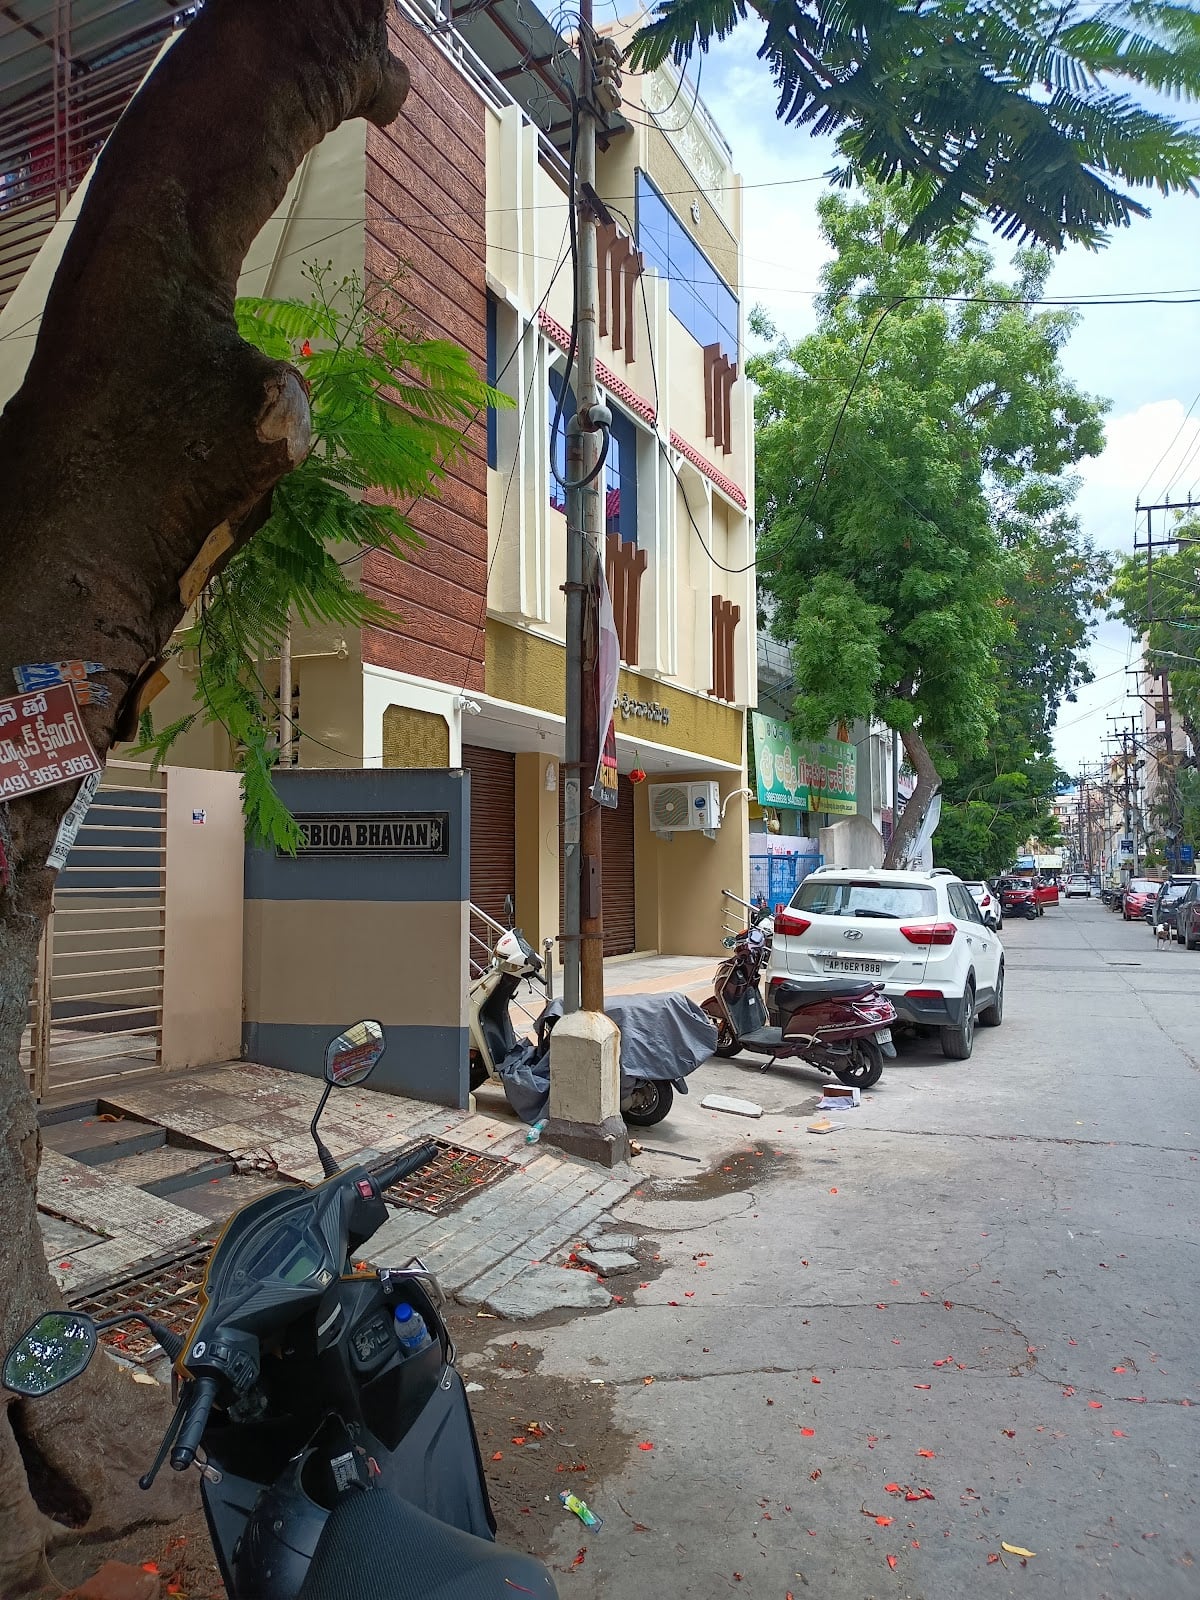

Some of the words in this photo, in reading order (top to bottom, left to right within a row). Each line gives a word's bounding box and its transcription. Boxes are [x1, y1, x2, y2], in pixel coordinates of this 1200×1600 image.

[22, 693, 48, 717] తో
[0, 773, 31, 797] 491
[30, 763, 62, 786] 365
[62, 753, 93, 777] 366
[355, 823, 428, 846] BHAVAN
